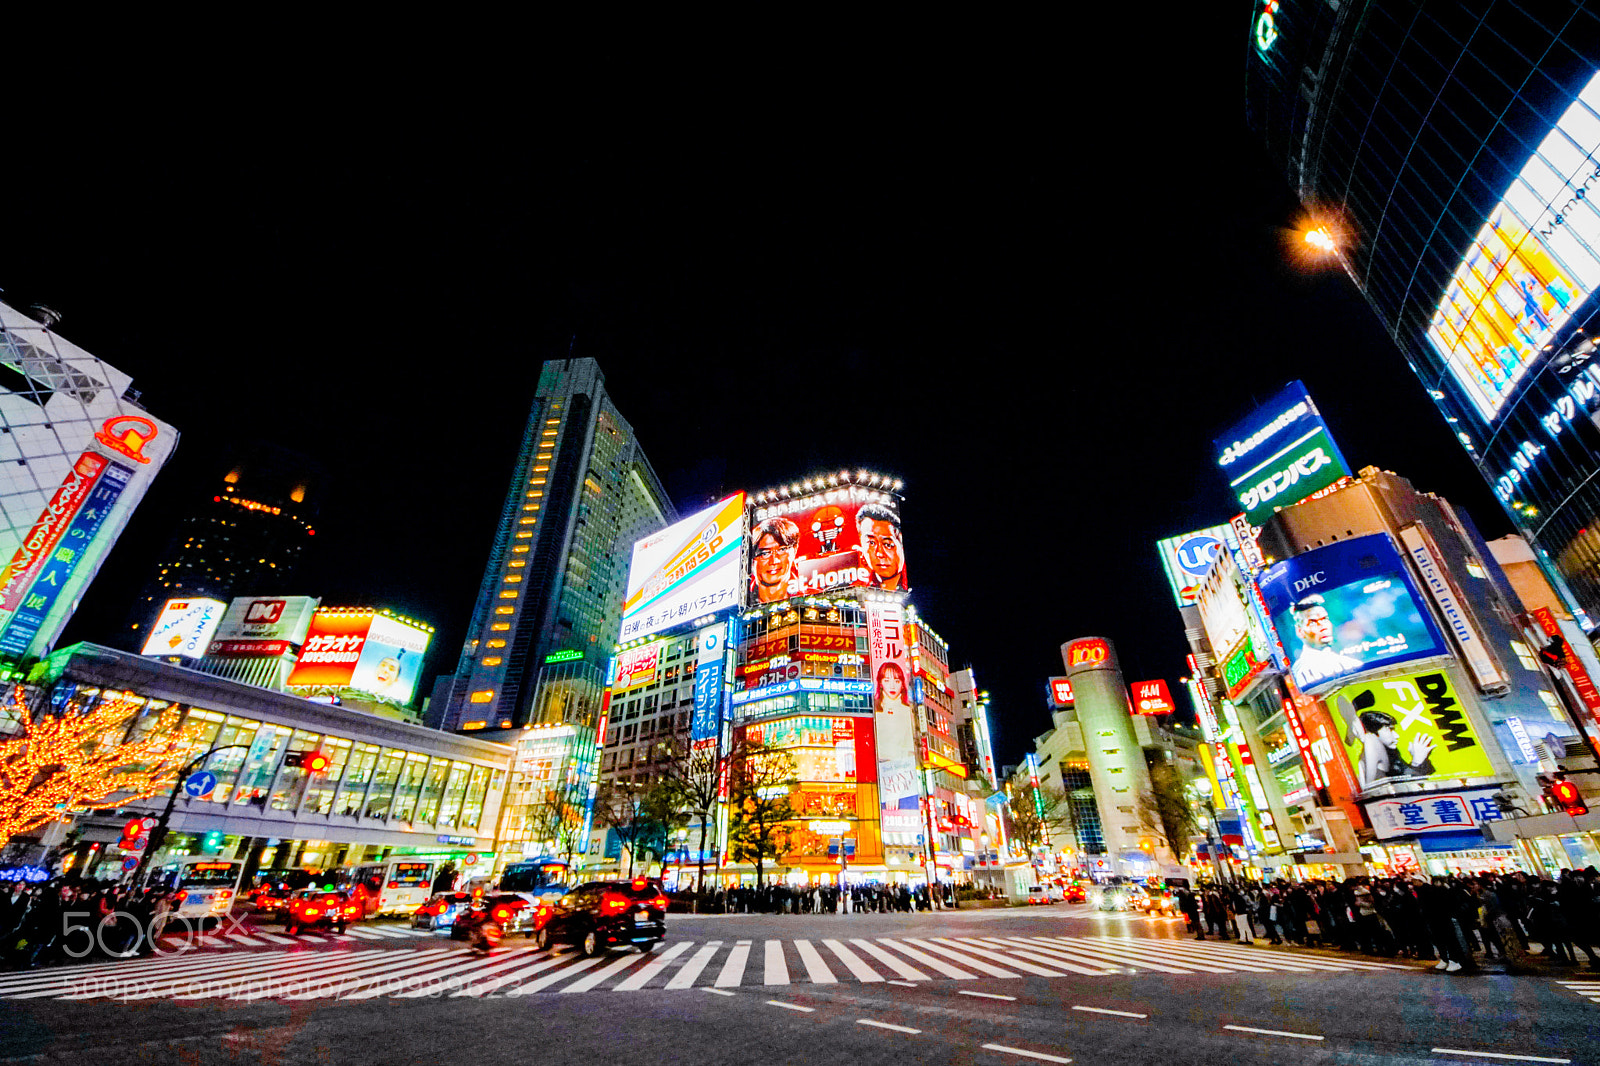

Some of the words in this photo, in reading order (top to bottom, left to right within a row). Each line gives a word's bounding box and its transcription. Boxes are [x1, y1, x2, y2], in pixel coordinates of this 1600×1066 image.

[1239, 447, 1332, 511] サロンパス
[1293, 570, 1327, 594] DHC
[623, 587, 736, 636] 日曜の夜はテレ朝バラエティ
[1439, 597, 1472, 643] neon
[305, 635, 364, 652] カラオケ
[800, 634, 855, 647] コンタクト
[883, 609, 903, 660] ニコル
[300, 651, 360, 663] JOYSOUND
[620, 658, 657, 675] クリニック
[837, 653, 865, 666] ガスト
[759, 671, 785, 687] ガスト
[1382, 680, 1434, 731] FX
[1414, 673, 1477, 753] DMM
